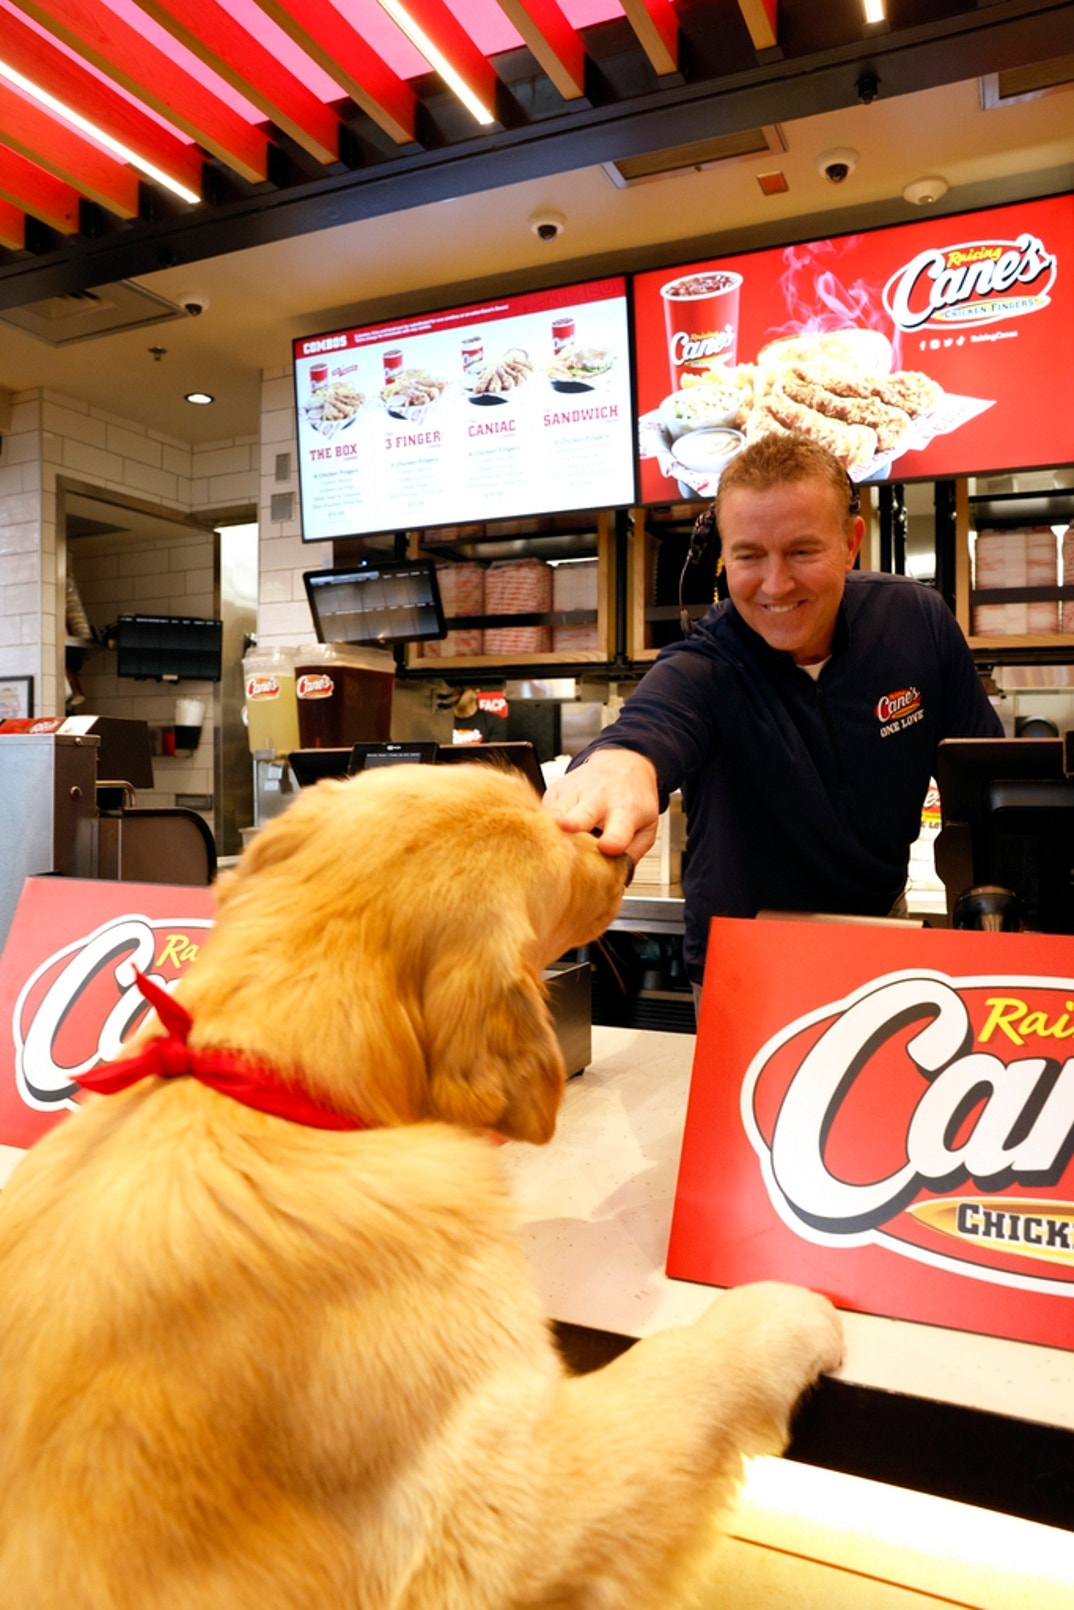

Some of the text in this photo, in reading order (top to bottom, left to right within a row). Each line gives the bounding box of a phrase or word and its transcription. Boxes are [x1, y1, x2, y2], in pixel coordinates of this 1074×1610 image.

[946, 246, 1003, 268] Raising
[893, 233, 1056, 330] Cane's
[943, 298, 1035, 319] CHICKEN FINGERS
[303, 335, 348, 355] COMBOS
[671, 324, 735, 366] Cane's
[468, 419, 516, 438] CANIAC
[543, 405, 619, 427] SANDWICH
[309, 449, 334, 462] THE
[335, 443, 358, 460] BOX
[385, 430, 441, 450] 3 FINGER
[877, 686, 921, 722] Cane's
[880, 708, 925, 738] ONE LOVE
[155, 934, 200, 969] Ra
[22, 919, 183, 1094] Ca
[978, 997, 1074, 1046] Rai
[957, 1202, 1074, 1250] CHICK
